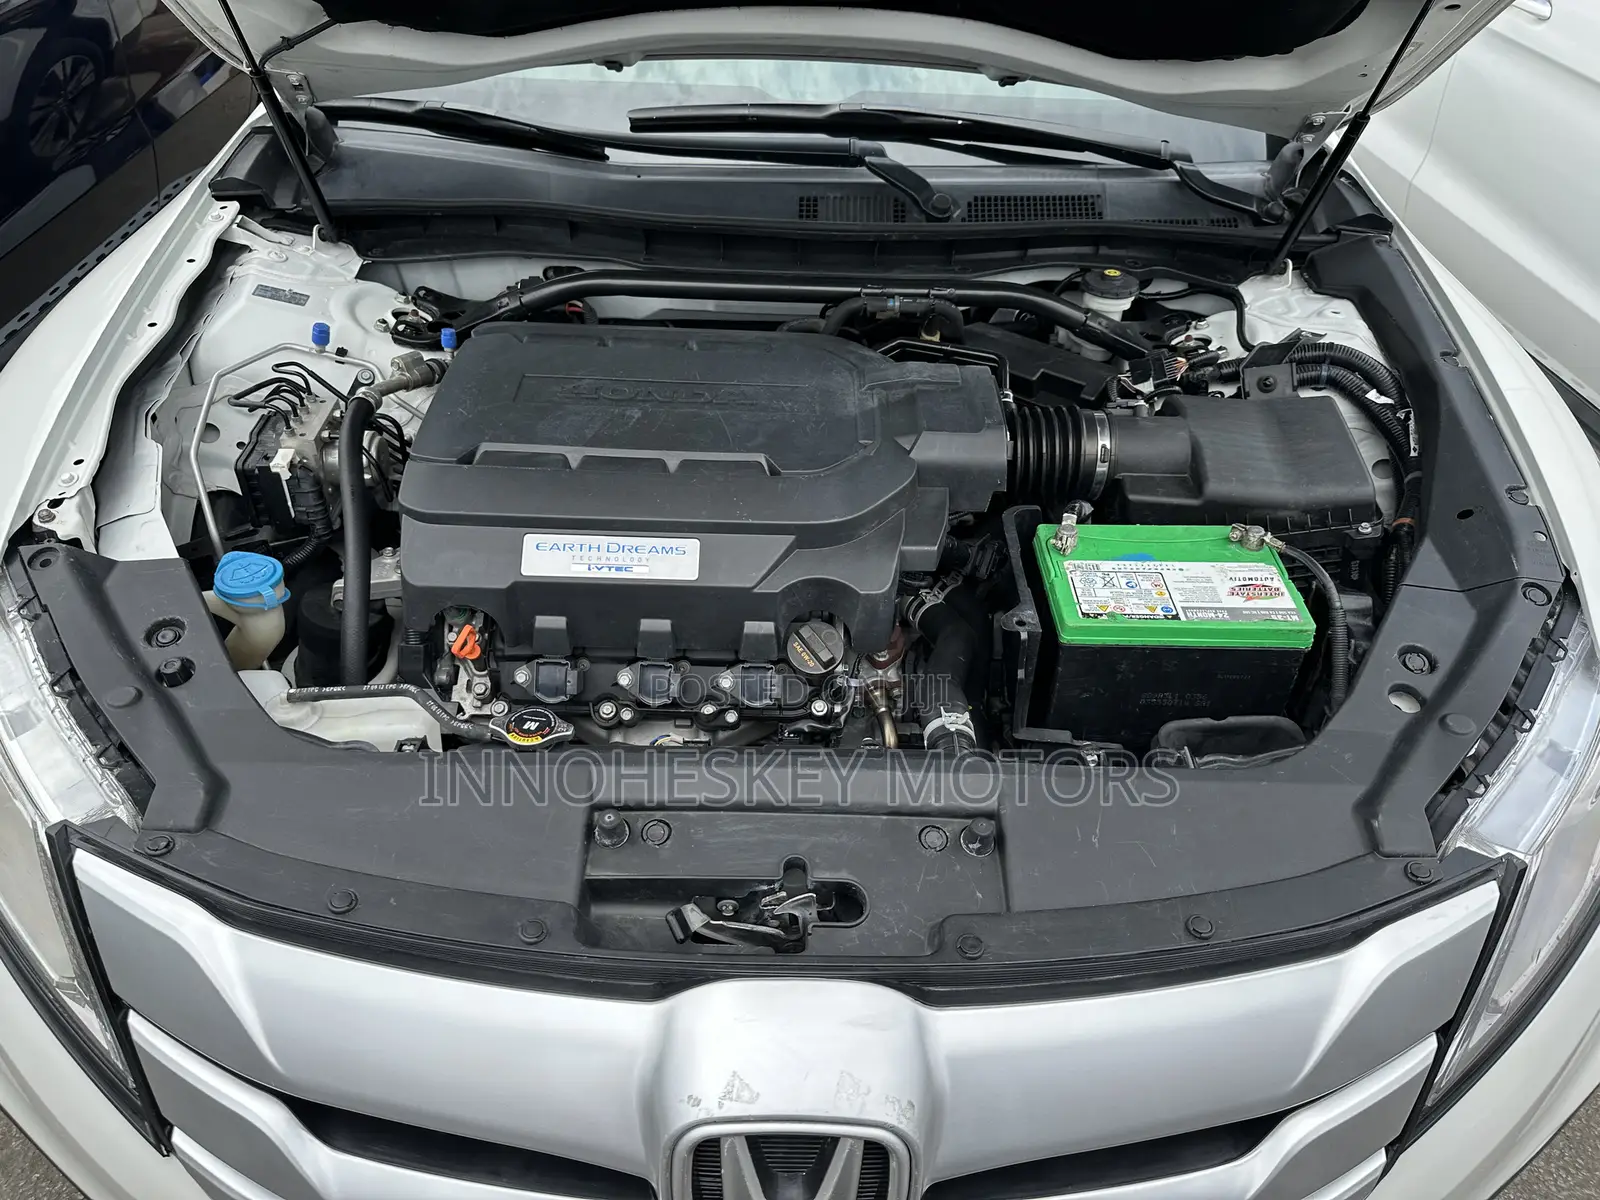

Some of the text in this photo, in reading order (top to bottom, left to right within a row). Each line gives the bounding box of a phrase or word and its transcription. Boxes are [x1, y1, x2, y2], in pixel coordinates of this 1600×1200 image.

[535, 542, 687, 556] EARTH DREAMS
[571, 555, 650, 563] TECHNOLOGY
[793, 641, 815, 668] SAE 0W-20
